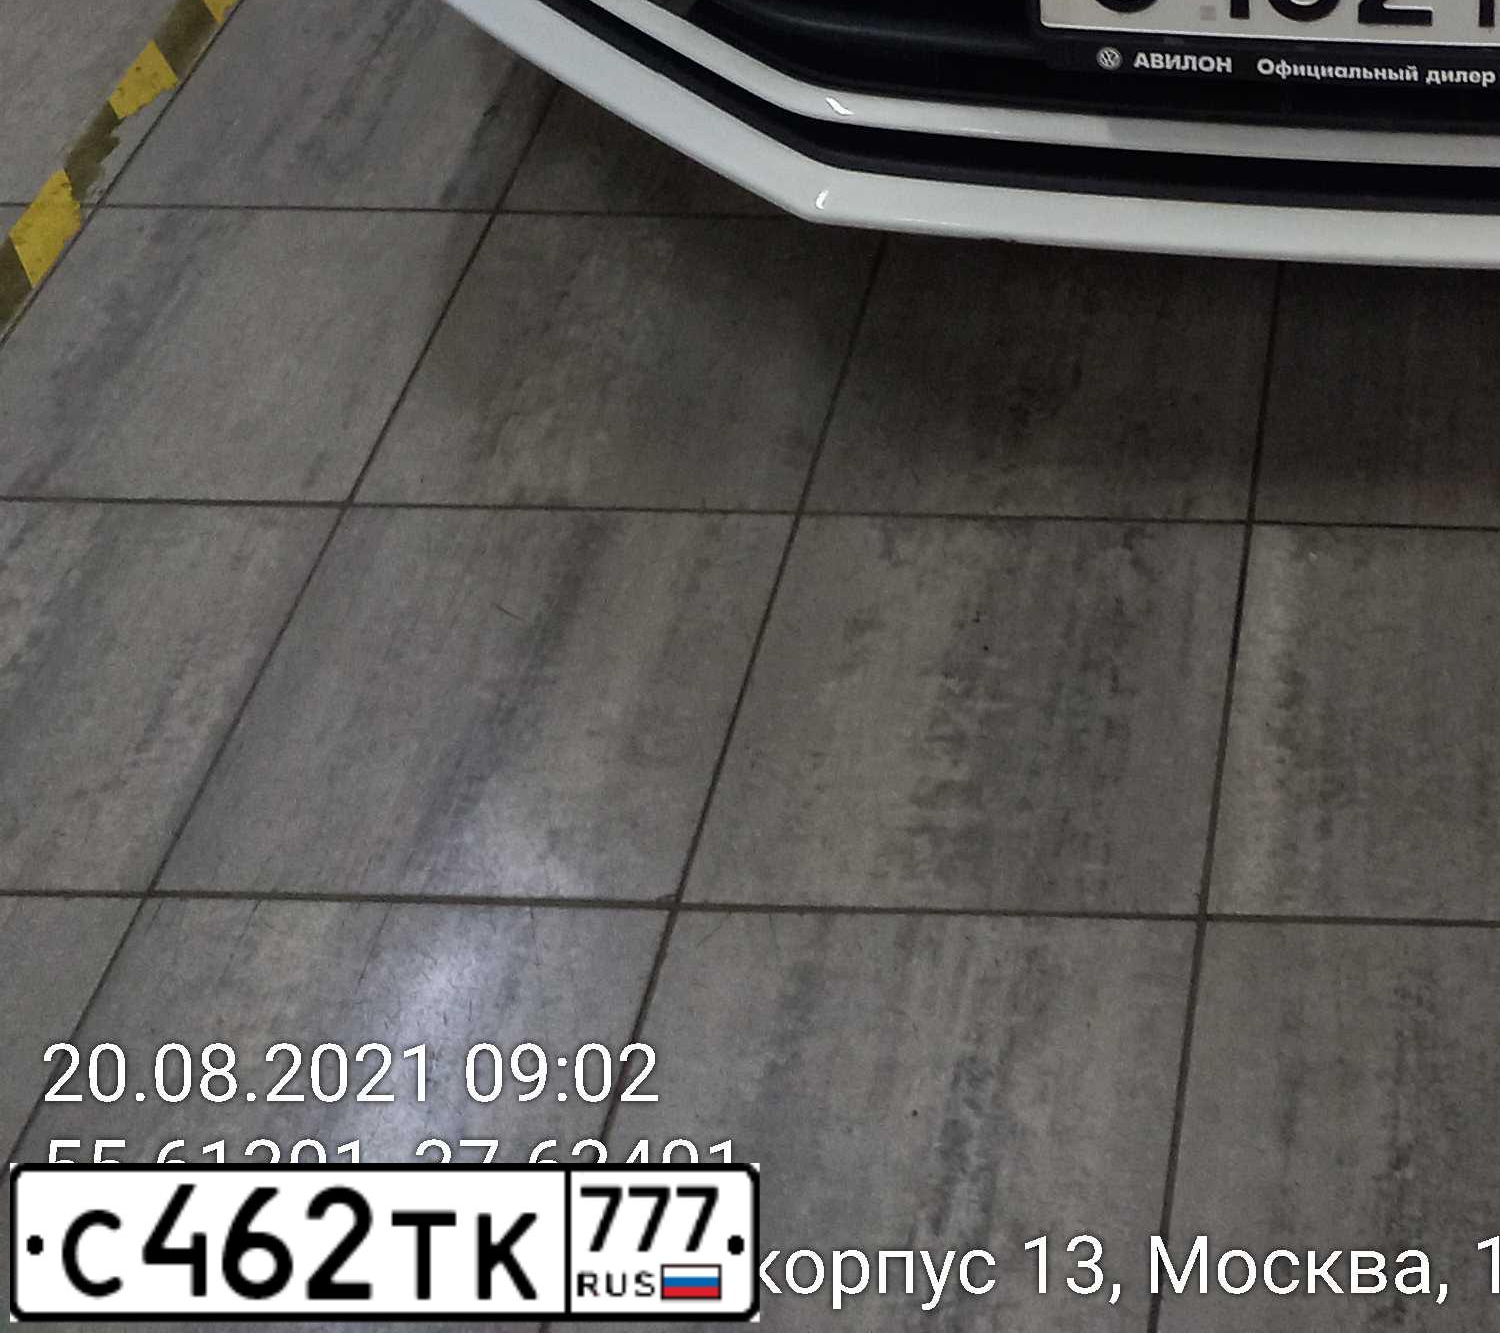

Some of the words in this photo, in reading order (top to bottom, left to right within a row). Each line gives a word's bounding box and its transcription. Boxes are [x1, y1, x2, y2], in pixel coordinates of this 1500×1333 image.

[1133, 51, 1233, 74] АВИЛОН
[1256, 57, 1420, 82] Официальный
[1425, 65, 1496, 88] дилер
